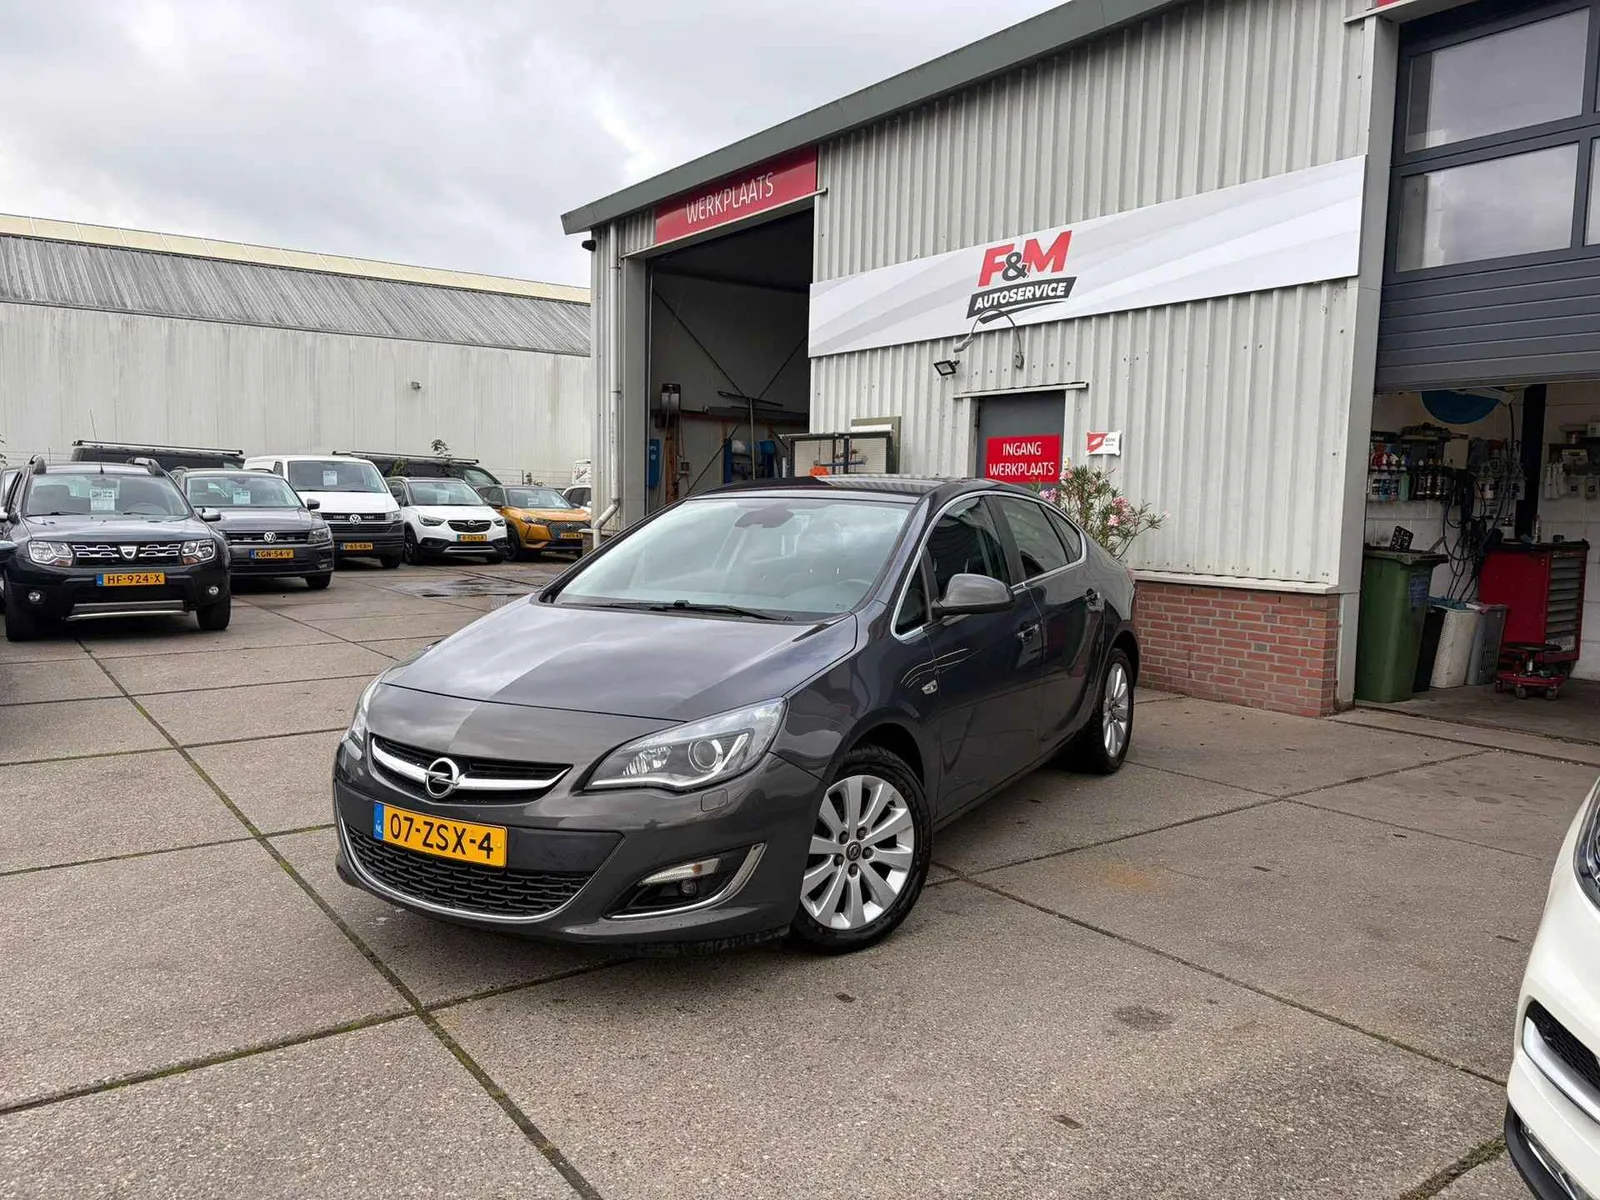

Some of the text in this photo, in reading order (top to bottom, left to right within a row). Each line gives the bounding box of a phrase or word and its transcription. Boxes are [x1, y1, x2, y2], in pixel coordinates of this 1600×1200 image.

[686, 172, 774, 224] WERKPLAATS
[978, 230, 1072, 287] F&M
[974, 282, 1067, 311] AUTOSERVICE
[1003, 442, 1042, 456] INGANG
[989, 462, 1055, 476] WERKPLAATS
[107, 573, 161, 585] HF-924-X
[390, 813, 493, 859] 07-ZSX-4
